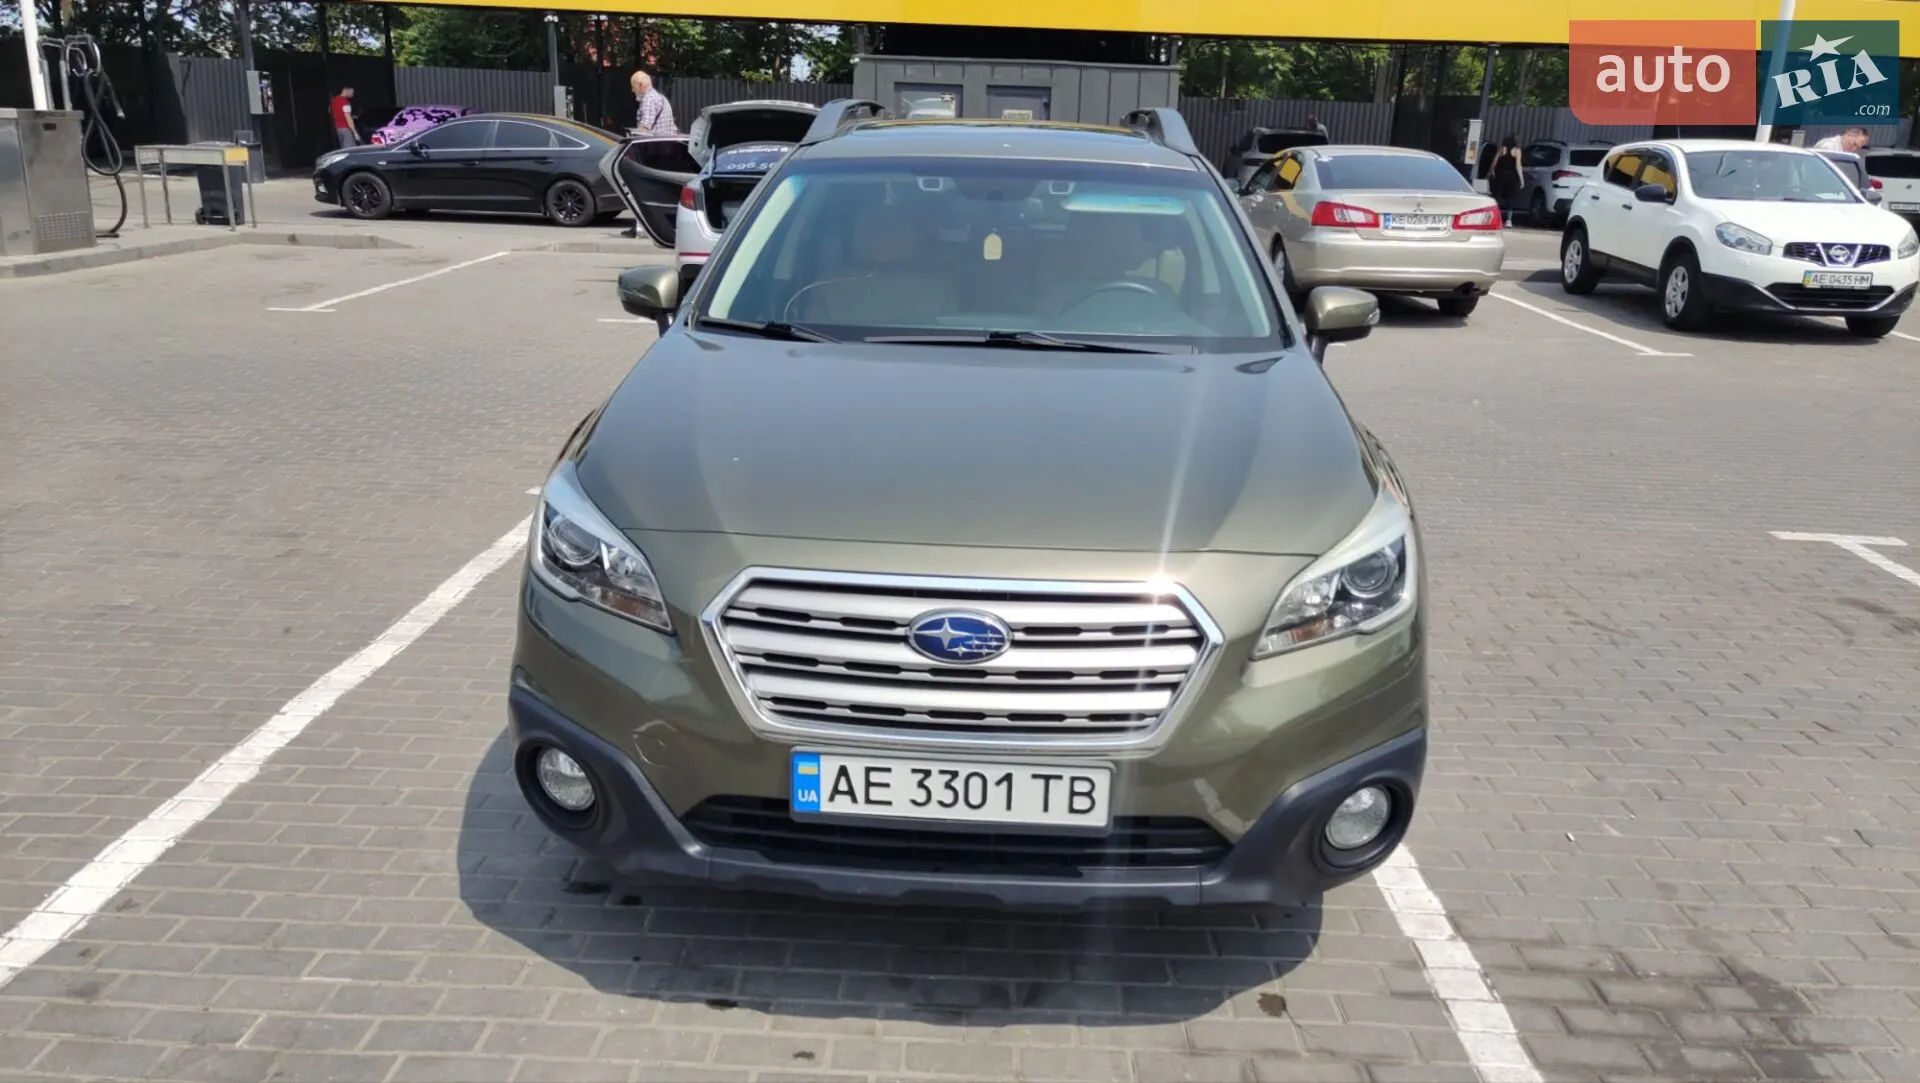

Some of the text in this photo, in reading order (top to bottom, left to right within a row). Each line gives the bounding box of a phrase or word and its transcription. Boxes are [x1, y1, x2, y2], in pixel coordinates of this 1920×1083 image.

[727, 161, 756, 170] 096
[1812, 273, 1827, 285] AE
[1829, 274, 1853, 286] 0435
[797, 788, 819, 803] UA
[827, 763, 1097, 815] AE 3301 TB
